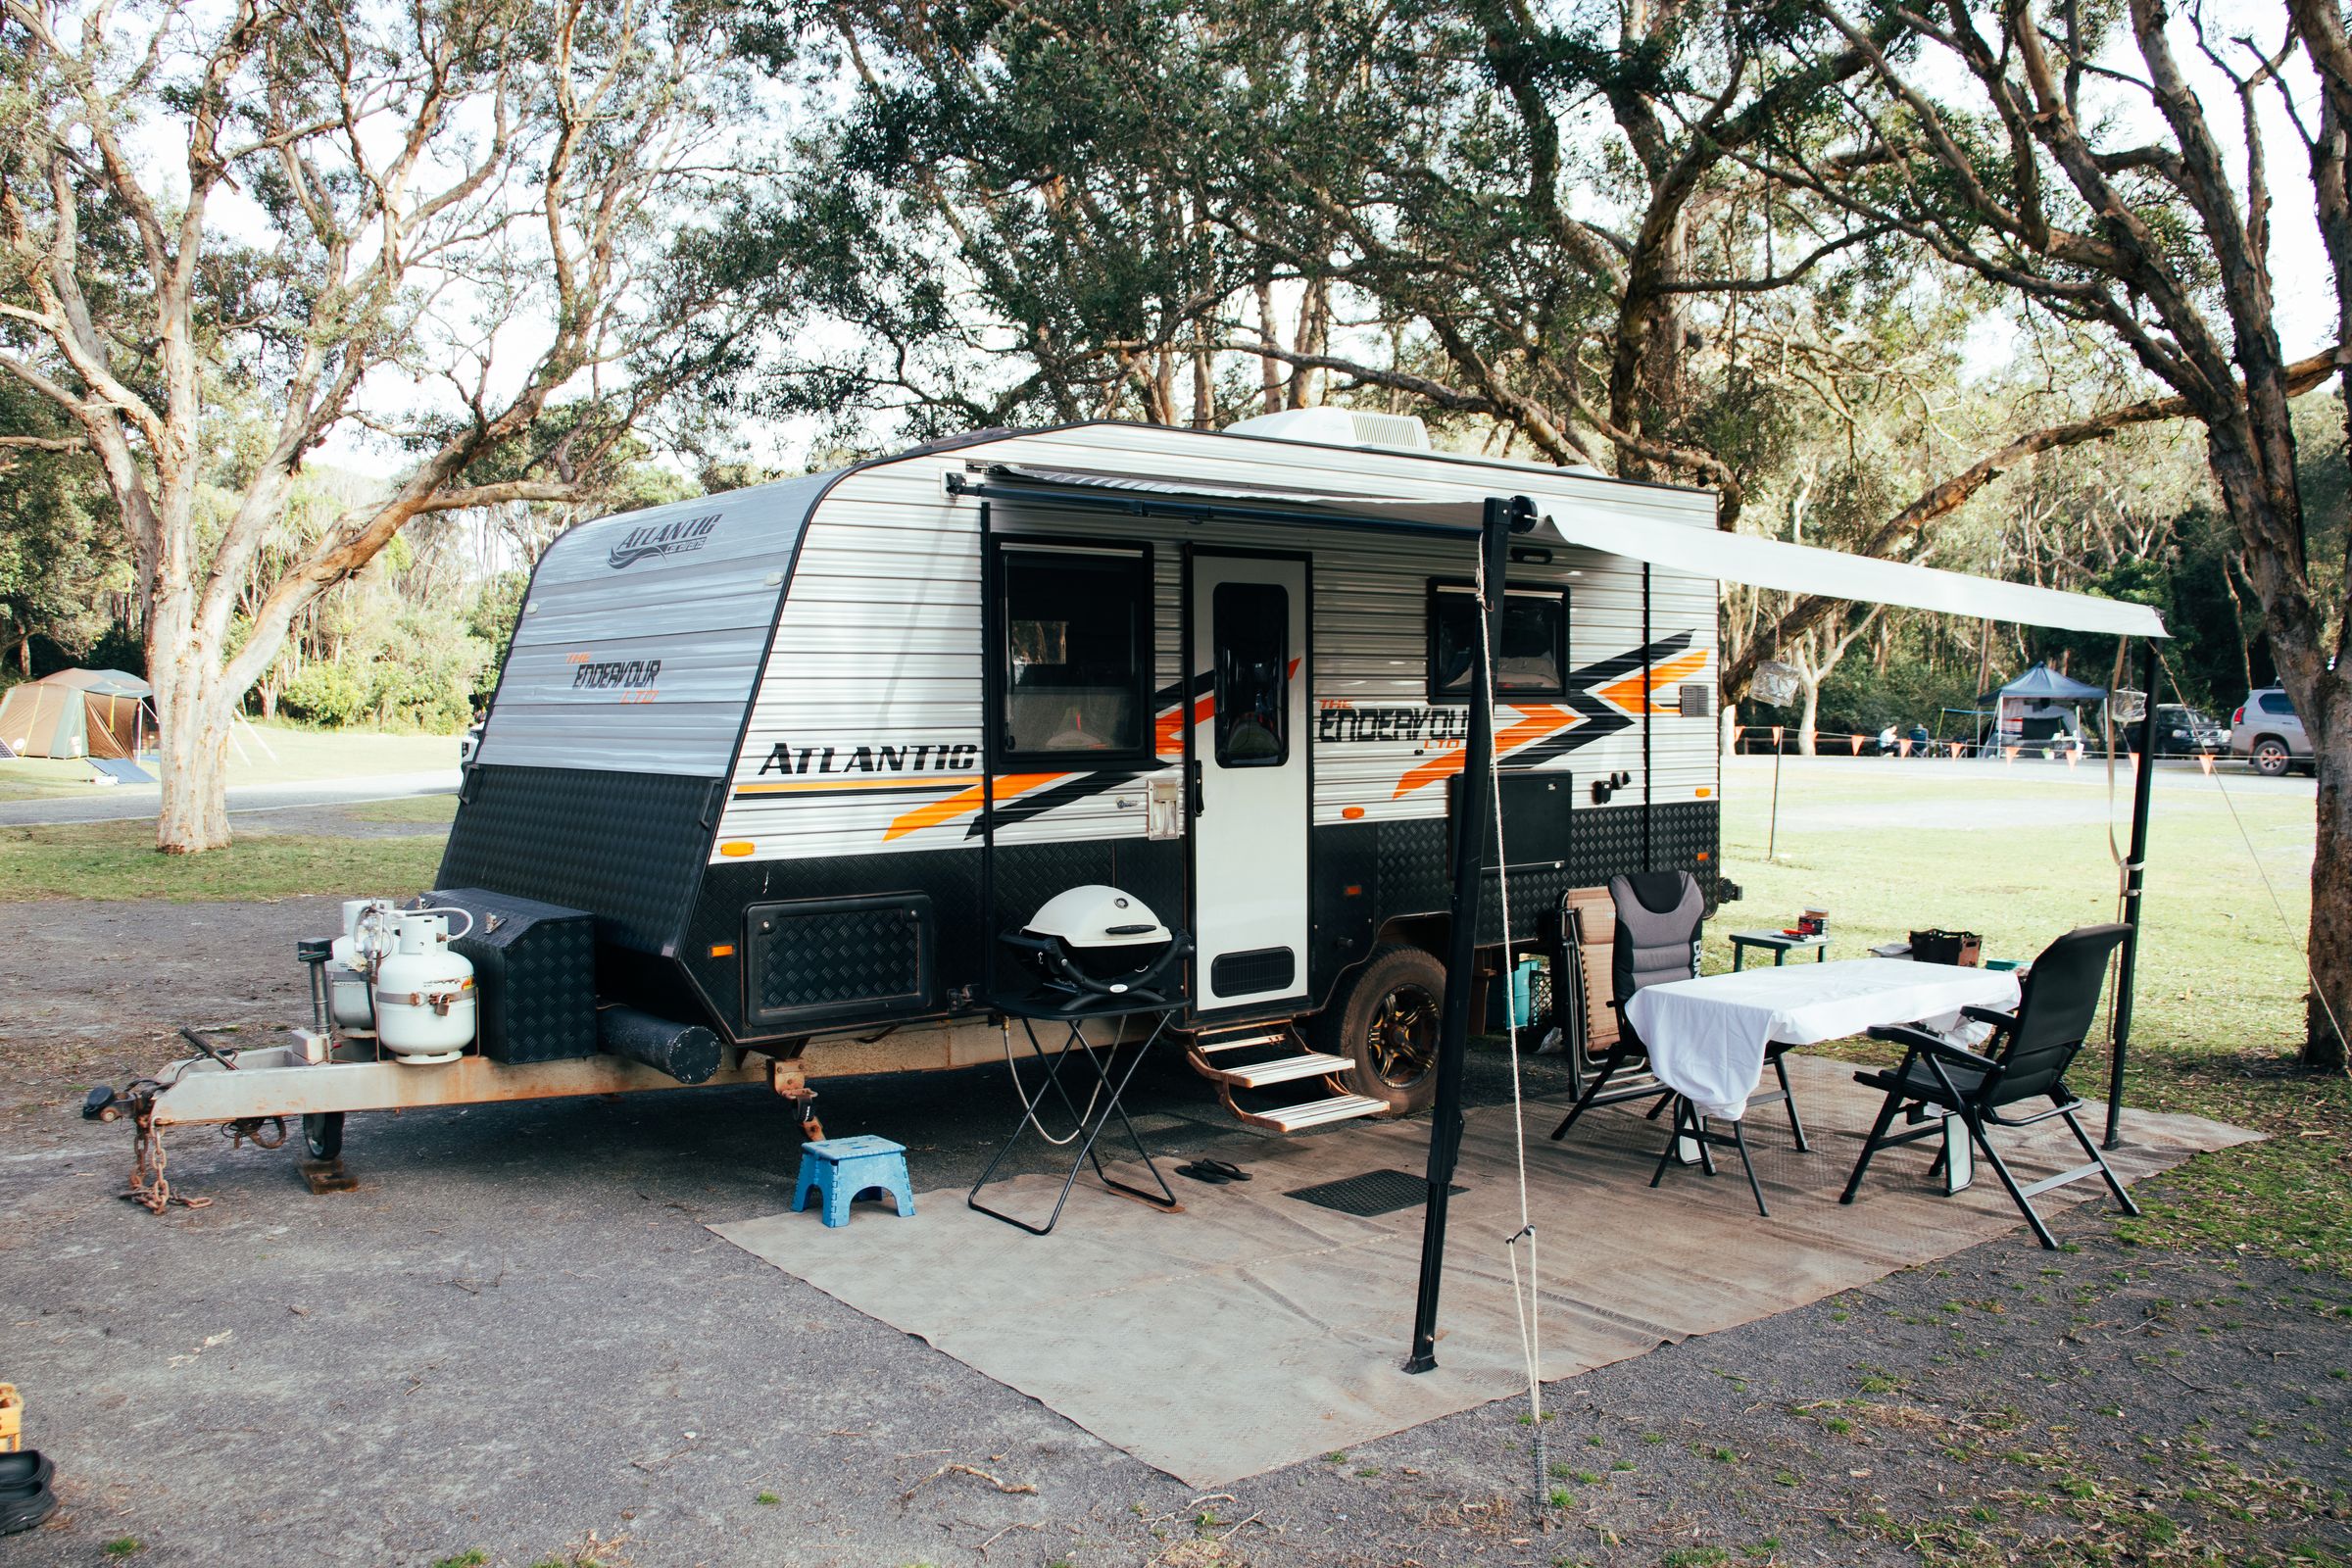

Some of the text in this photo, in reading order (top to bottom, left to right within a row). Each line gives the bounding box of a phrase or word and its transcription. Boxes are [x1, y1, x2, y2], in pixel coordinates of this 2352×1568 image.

[616, 514, 723, 550] ATLANTIC
[565, 652, 591, 664] THE
[572, 660, 662, 690] ENDEAVOUR
[1319, 699, 1354, 709] THE
[1319, 708, 1468, 742] ENDEAVOU
[758, 743, 978, 775] ATLANTIC
[1424, 739, 1460, 749] LTD
